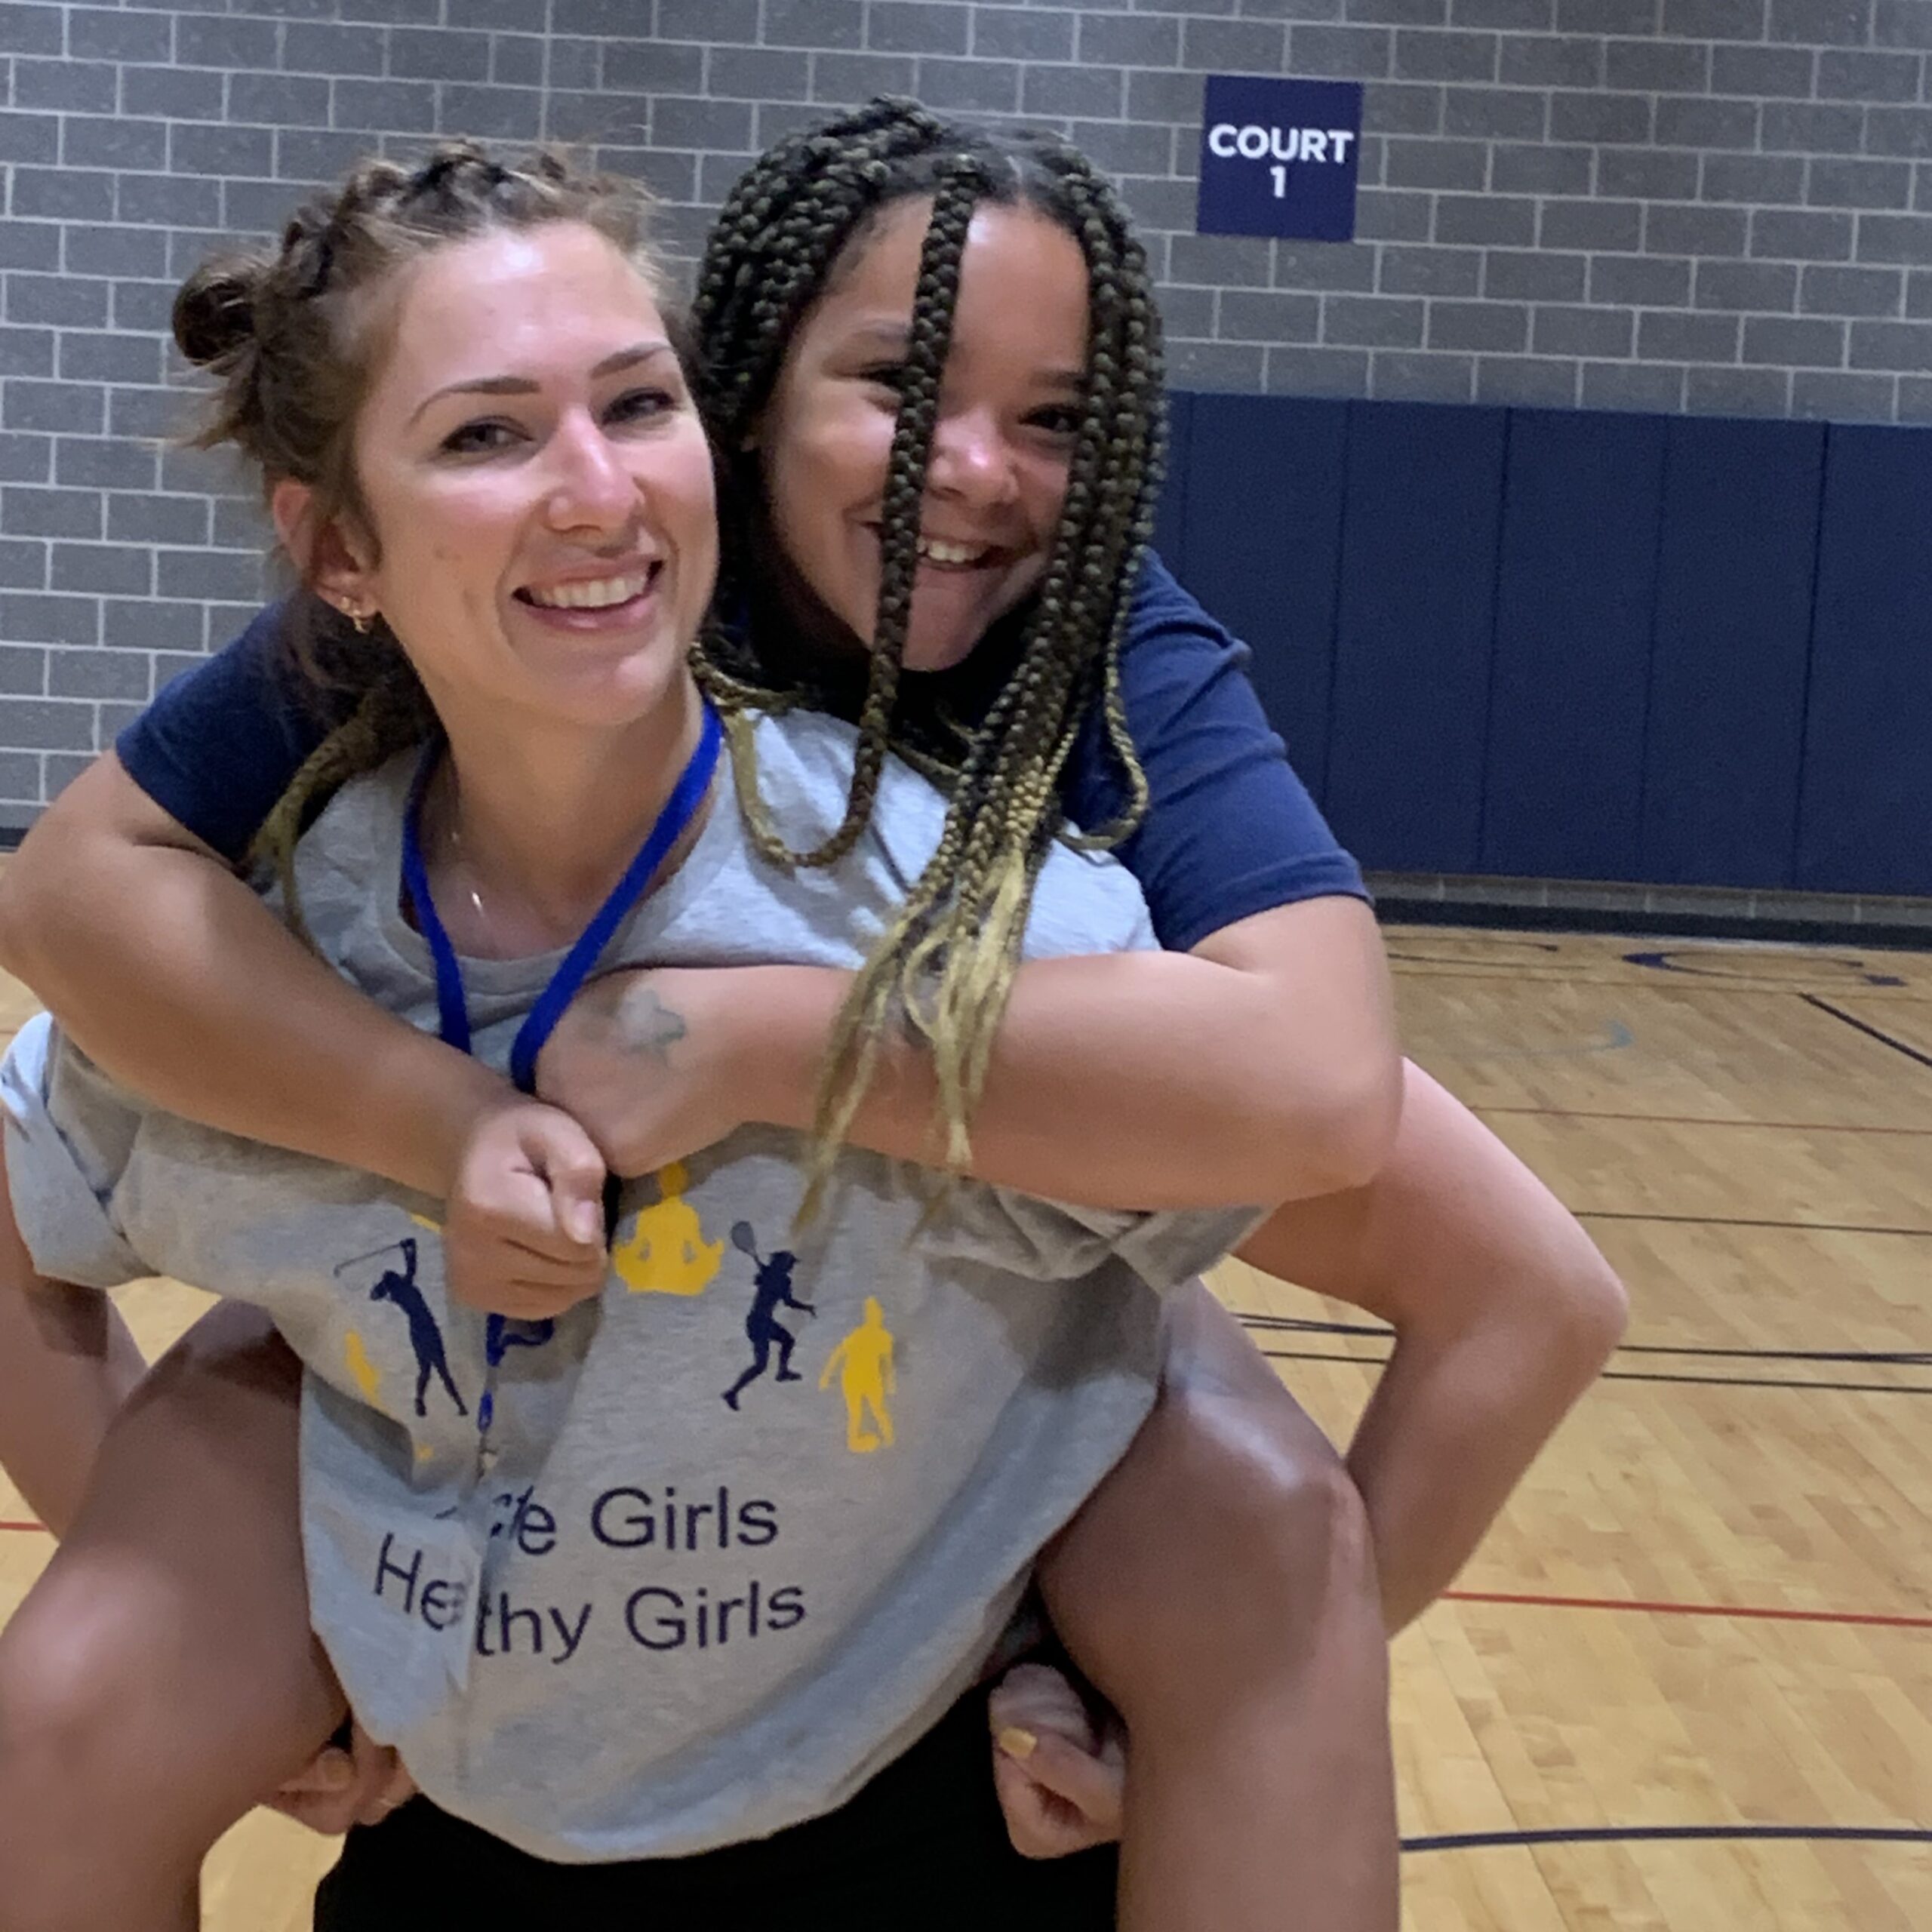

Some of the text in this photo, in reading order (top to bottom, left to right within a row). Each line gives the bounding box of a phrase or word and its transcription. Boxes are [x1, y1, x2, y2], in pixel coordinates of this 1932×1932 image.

[1208, 124, 1355, 163] COURT
[1270, 165, 1286, 198] 1
[591, 1486, 779, 1550] Girls
[625, 1581, 806, 1651] Girls
